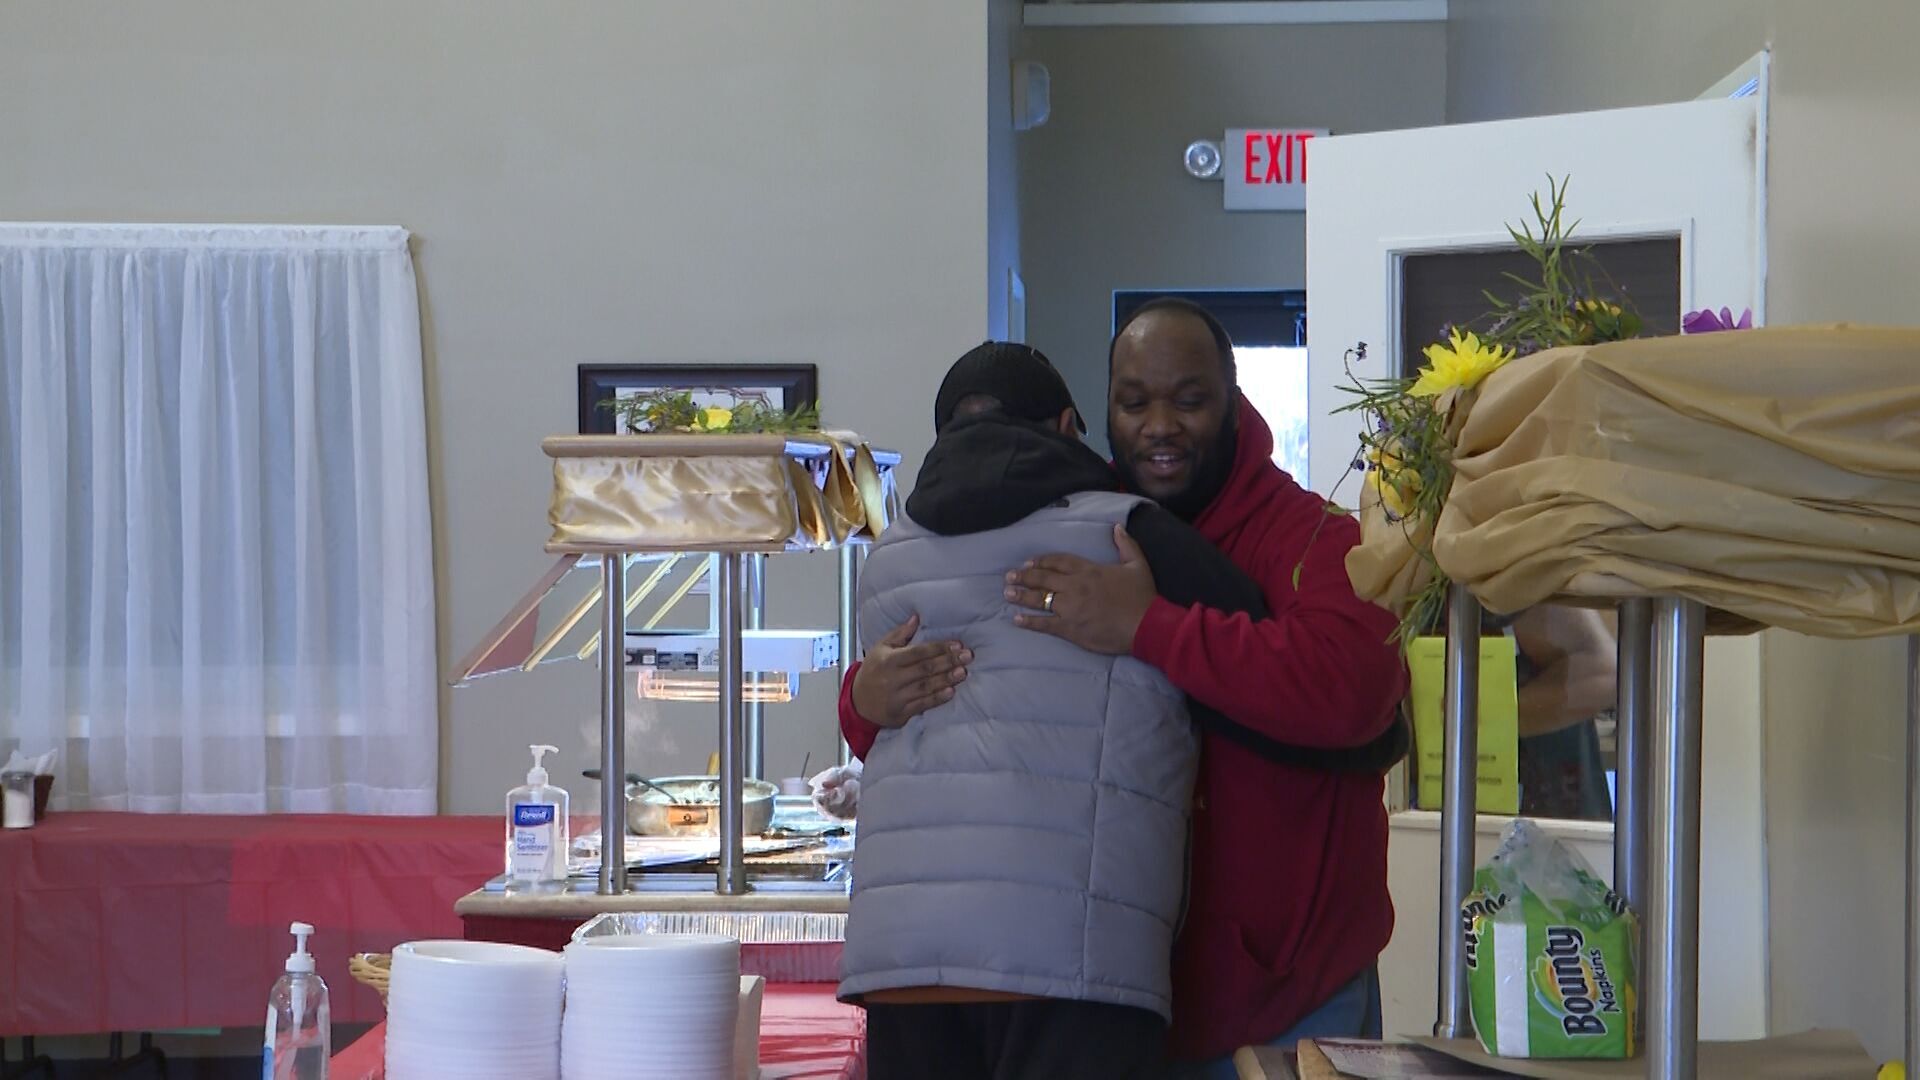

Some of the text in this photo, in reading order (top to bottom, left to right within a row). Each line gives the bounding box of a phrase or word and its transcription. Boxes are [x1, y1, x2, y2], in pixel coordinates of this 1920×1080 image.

[1245, 132, 1315, 184] EXIT
[517, 836, 536, 844] Hand
[1545, 927, 1607, 1036] Bounty
[1590, 948, 1620, 1012] Napkins
